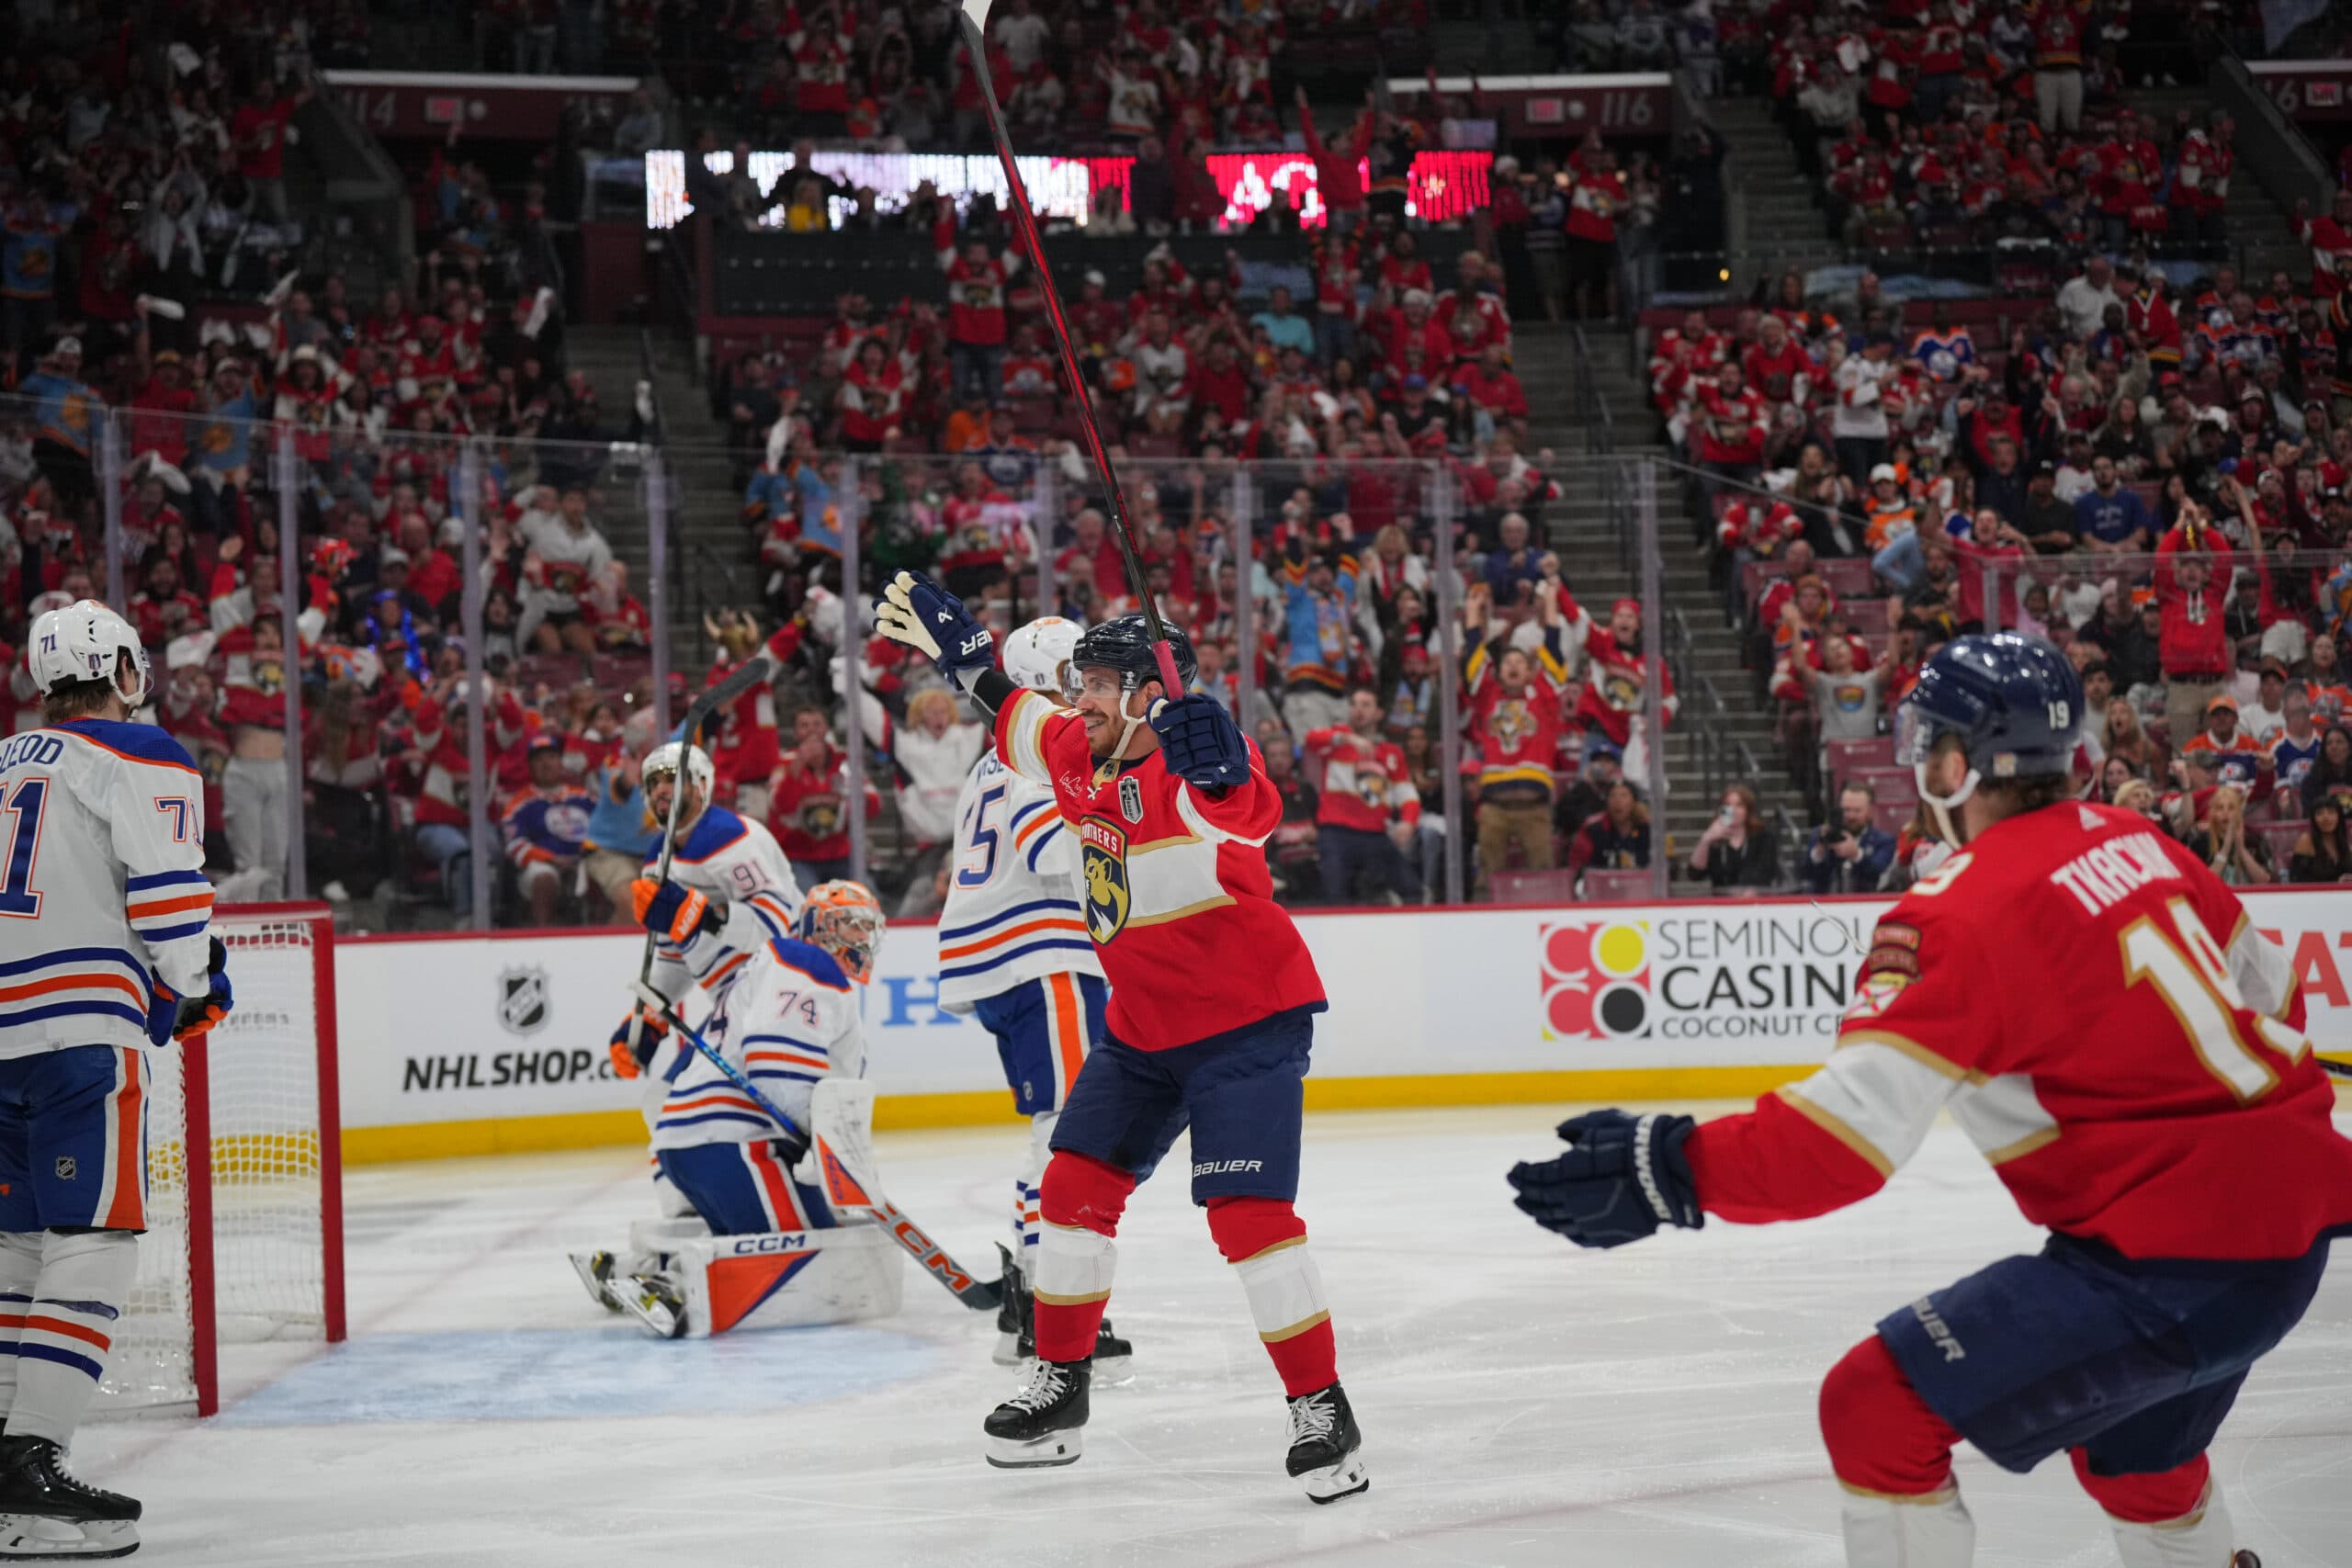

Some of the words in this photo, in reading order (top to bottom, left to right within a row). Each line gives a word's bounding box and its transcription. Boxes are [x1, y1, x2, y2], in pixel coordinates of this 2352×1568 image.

[1600, 91, 1652, 127] 116
[40, 633, 57, 654] 71
[2048, 699, 2071, 730] 19
[0, 734, 64, 773] LEOD
[0, 777, 50, 919] 1
[953, 779, 1009, 890] 5
[733, 860, 777, 894] 91
[777, 990, 818, 1033] 74
[1661, 1014, 1807, 1039] COCONUT
[401, 1049, 622, 1092] NHLSHOP.c
[1193, 1159, 1264, 1178] BAUER
[734, 1235, 807, 1255] CCM
